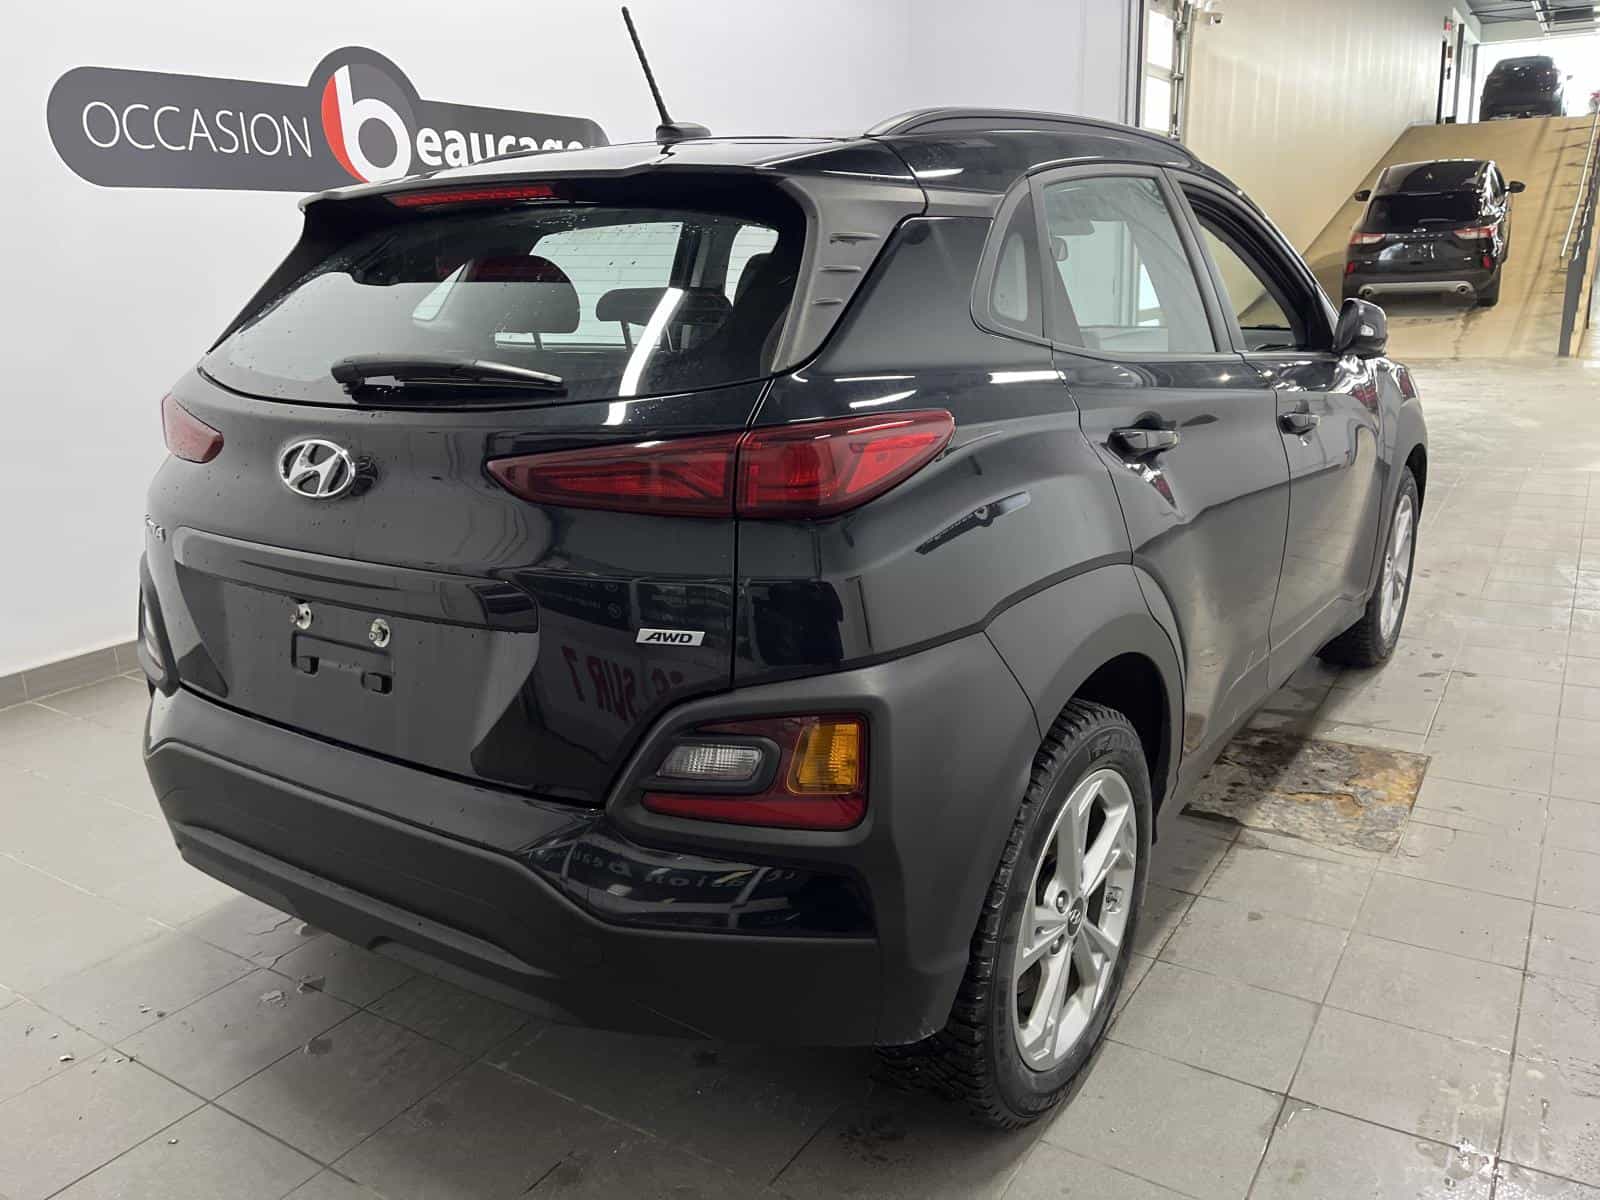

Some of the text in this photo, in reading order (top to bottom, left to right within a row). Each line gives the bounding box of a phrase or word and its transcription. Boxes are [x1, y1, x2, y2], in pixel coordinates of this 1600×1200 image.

[82, 65, 584, 182] OCCASION beauc
[645, 632, 693, 643] AWD
